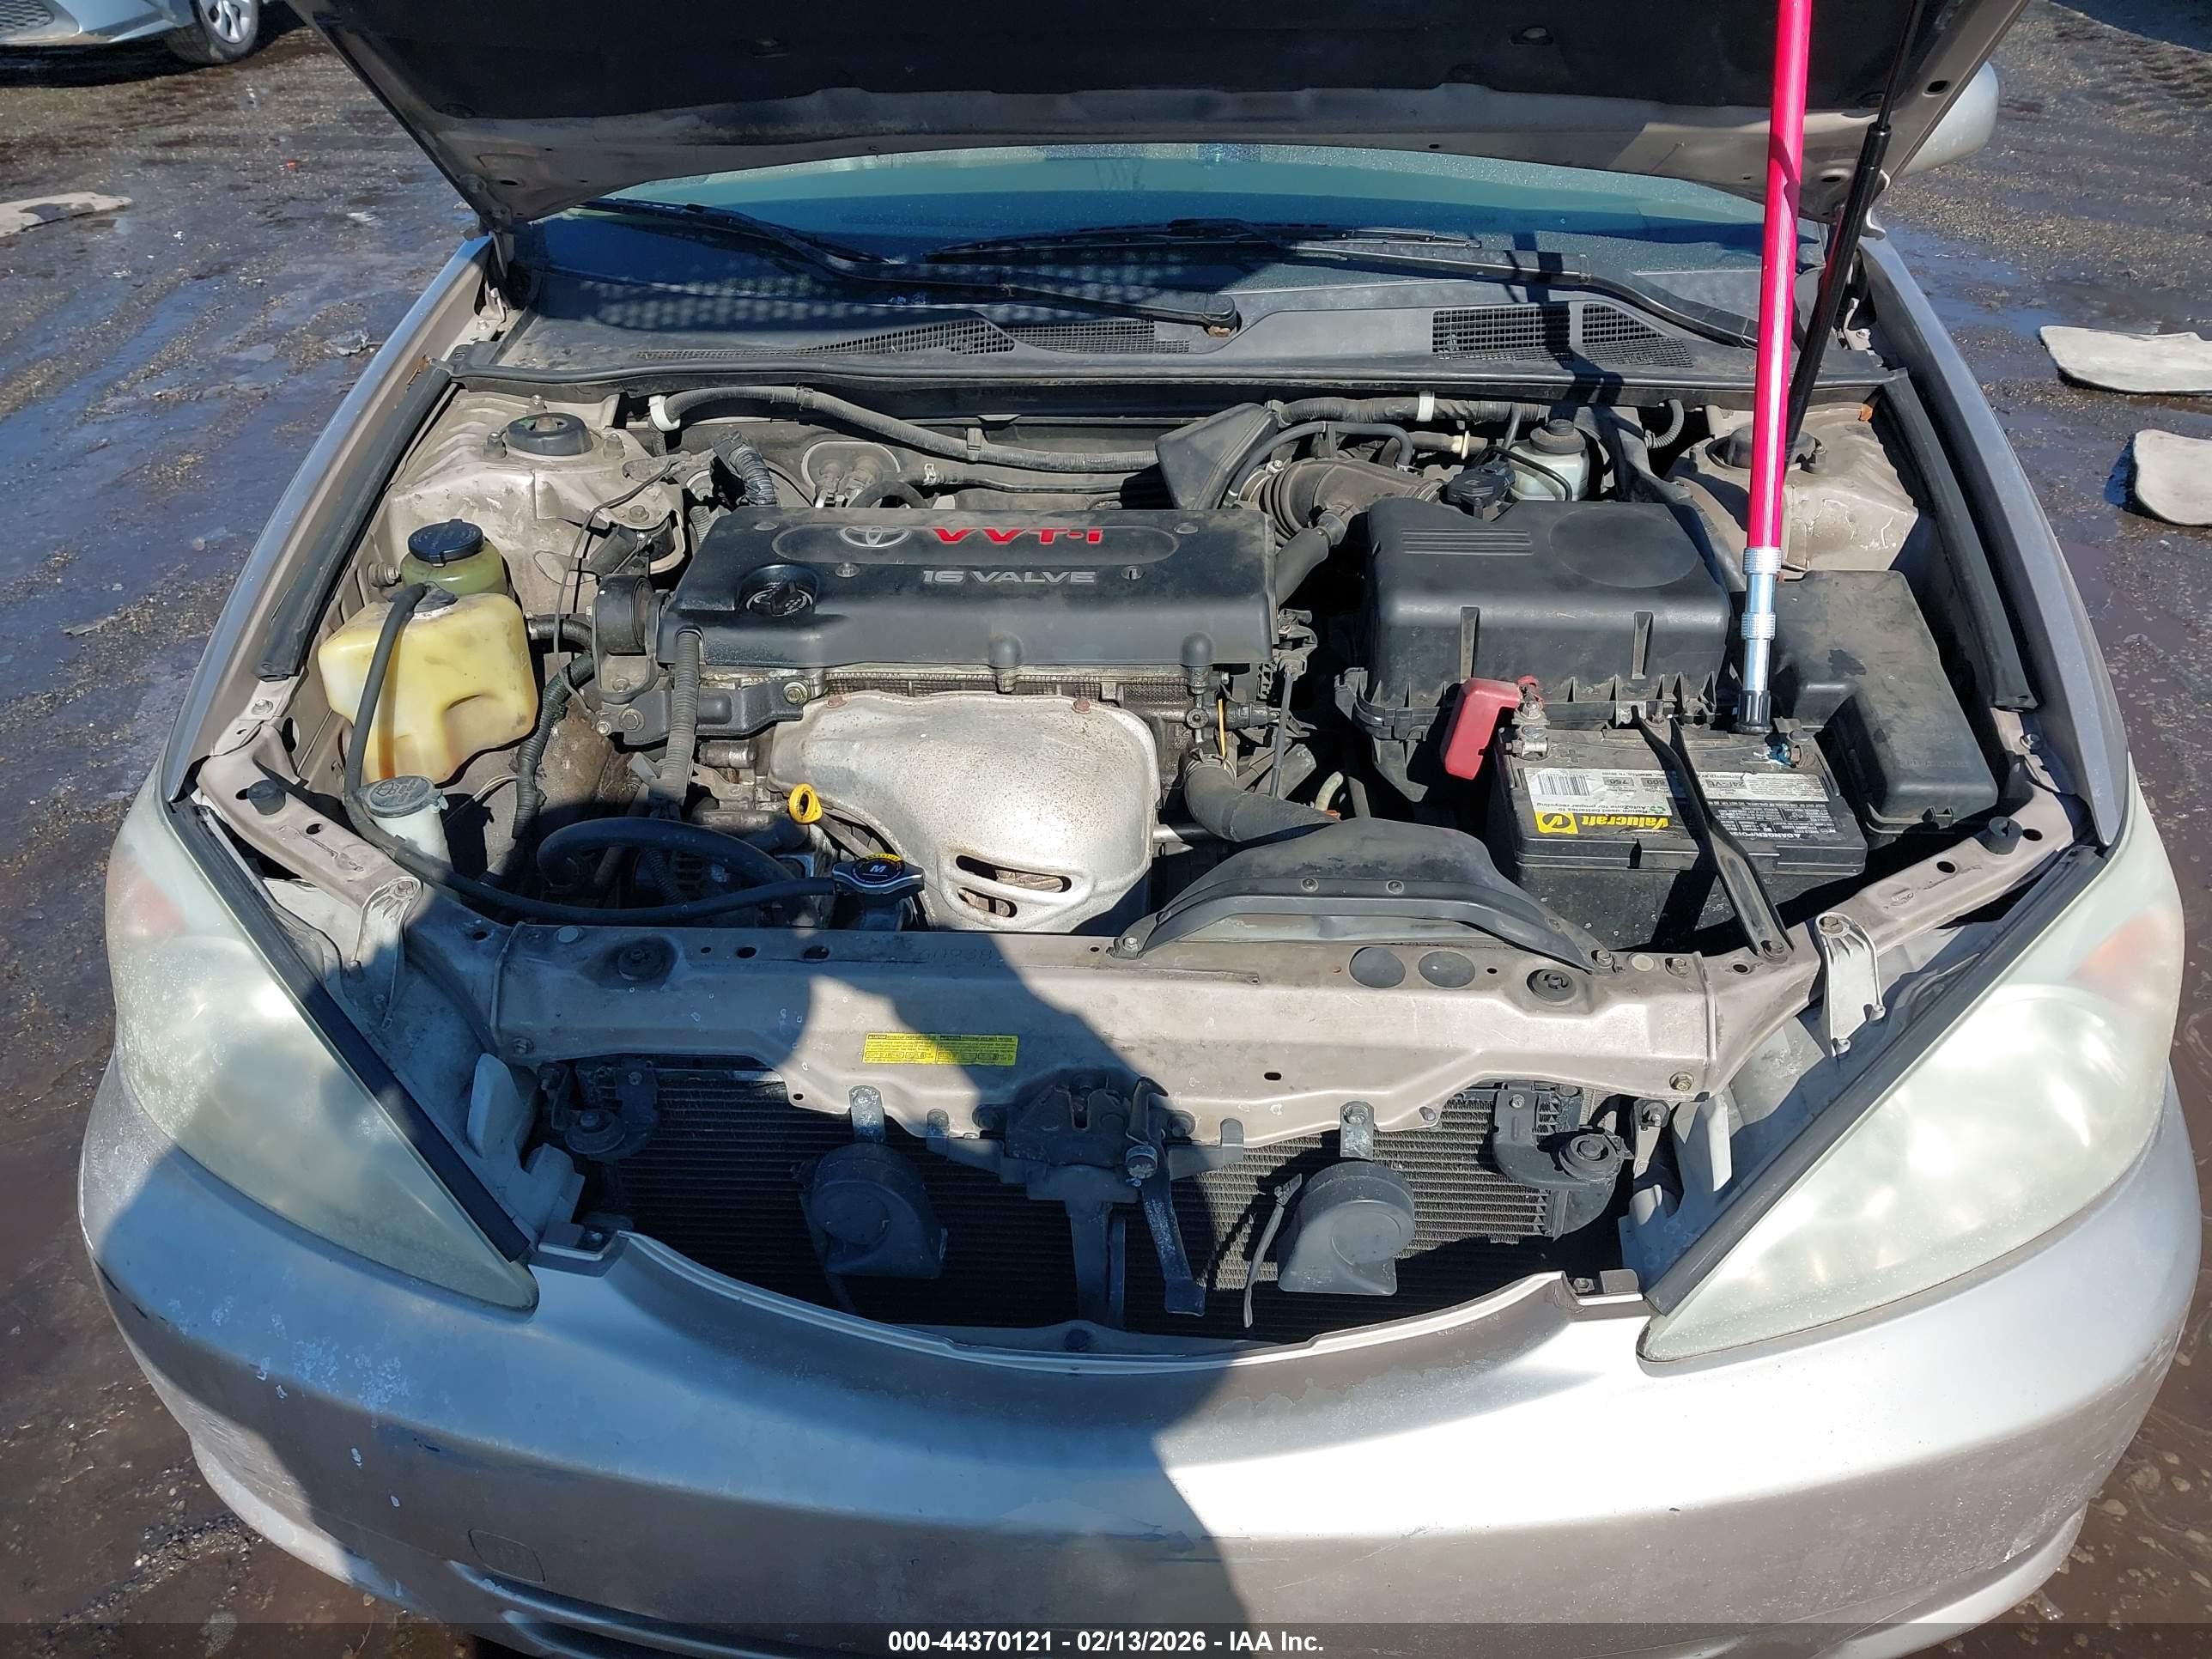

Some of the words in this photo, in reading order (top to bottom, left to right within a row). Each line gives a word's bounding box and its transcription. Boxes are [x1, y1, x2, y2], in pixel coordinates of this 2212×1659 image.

[923, 570, 964, 583] 16
[971, 571, 1096, 584] VALVE
[1581, 815, 1668, 830] Valucraft
